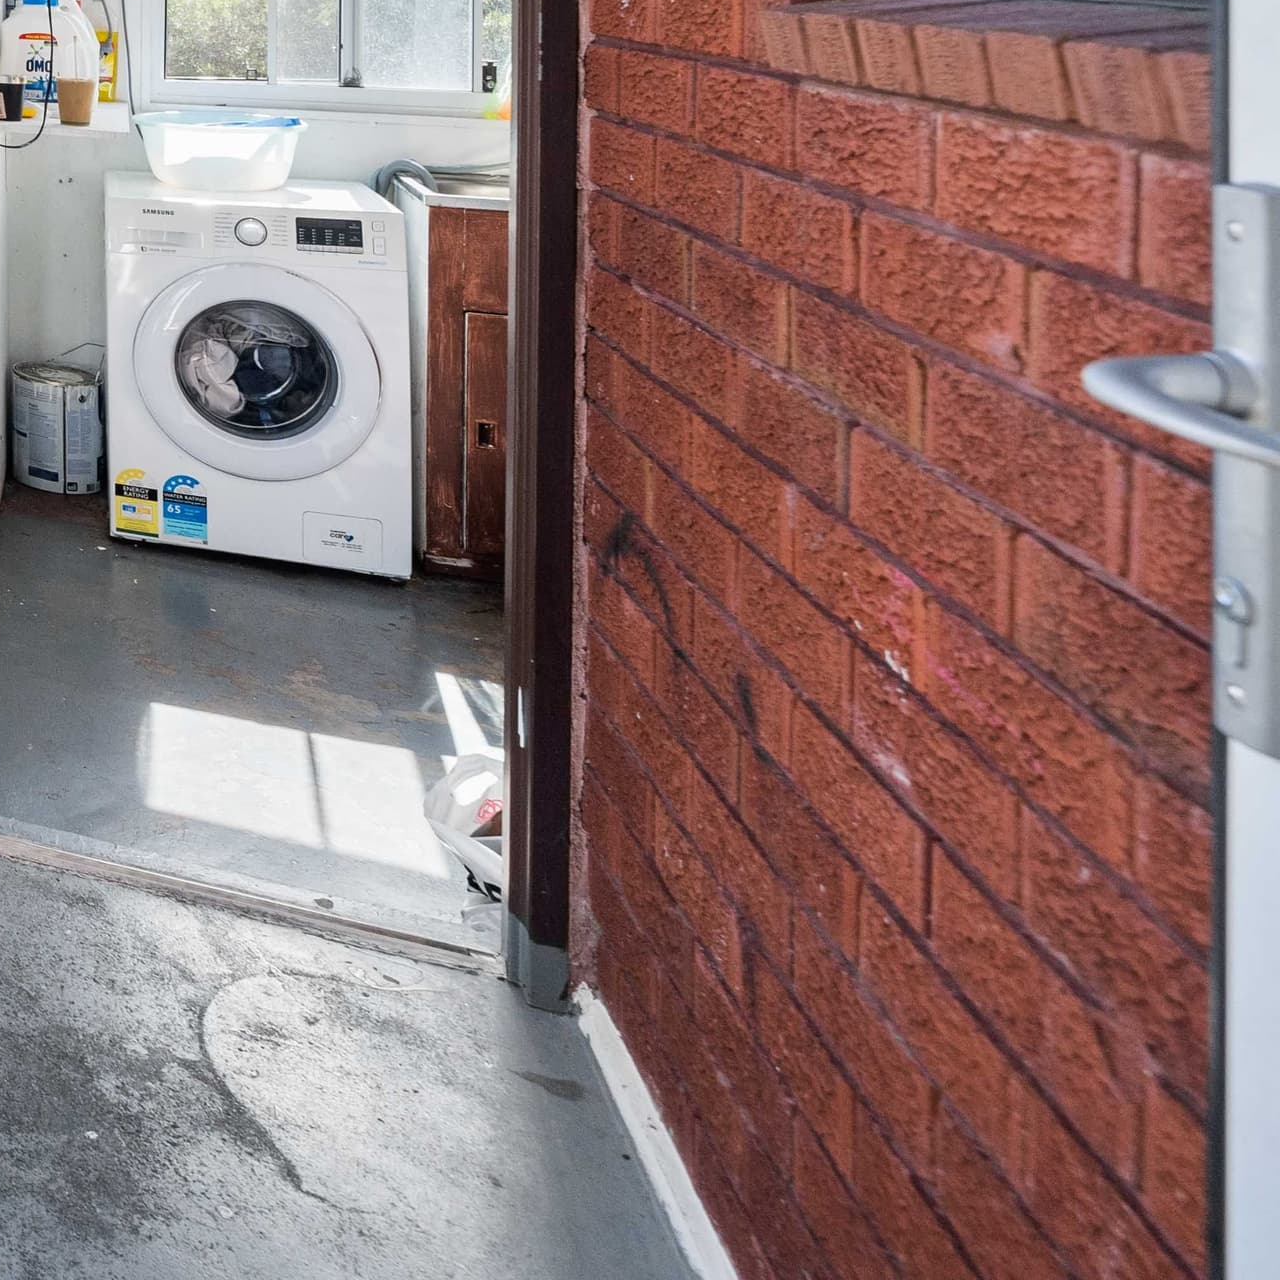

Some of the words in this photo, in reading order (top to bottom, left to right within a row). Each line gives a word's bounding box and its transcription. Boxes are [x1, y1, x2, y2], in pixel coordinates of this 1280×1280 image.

[142, 208, 175, 216] SAMSUNG
[123, 491, 149, 500] RATING
[167, 504, 181, 514] 65
